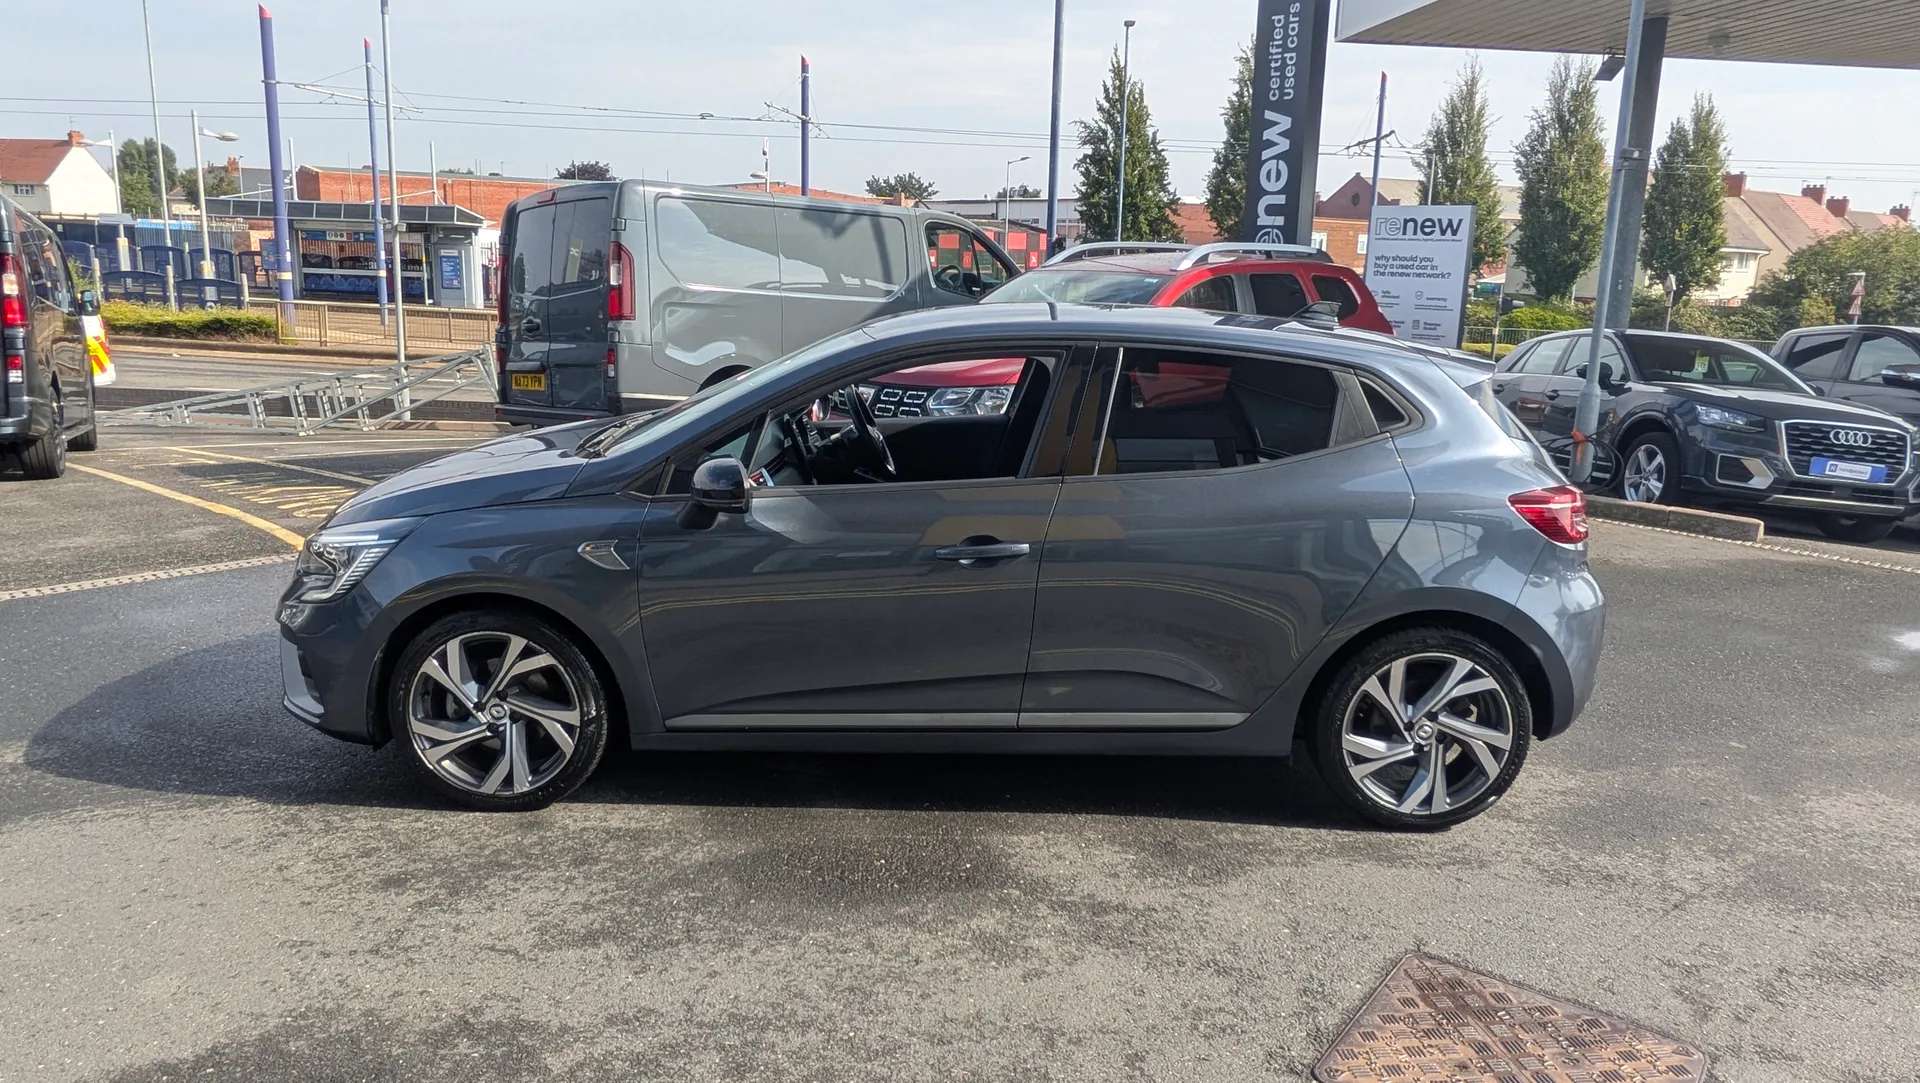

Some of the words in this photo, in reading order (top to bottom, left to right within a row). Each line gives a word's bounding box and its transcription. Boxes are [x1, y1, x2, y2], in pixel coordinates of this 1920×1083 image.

[1287, 2, 1301, 49] cars
[1268, 14, 1285, 101] certified
[1283, 52, 1297, 100] used
[1255, 109, 1292, 244] enew
[1374, 216, 1464, 237] renew
[1374, 254, 1391, 263] why
[1391, 254, 1418, 263] should
[1418, 256, 1434, 264] you
[1374, 262, 1390, 270] buy
[1395, 262, 1415, 270] used
[1430, 263, 1438, 271] in
[1412, 271, 1452, 280] network?
